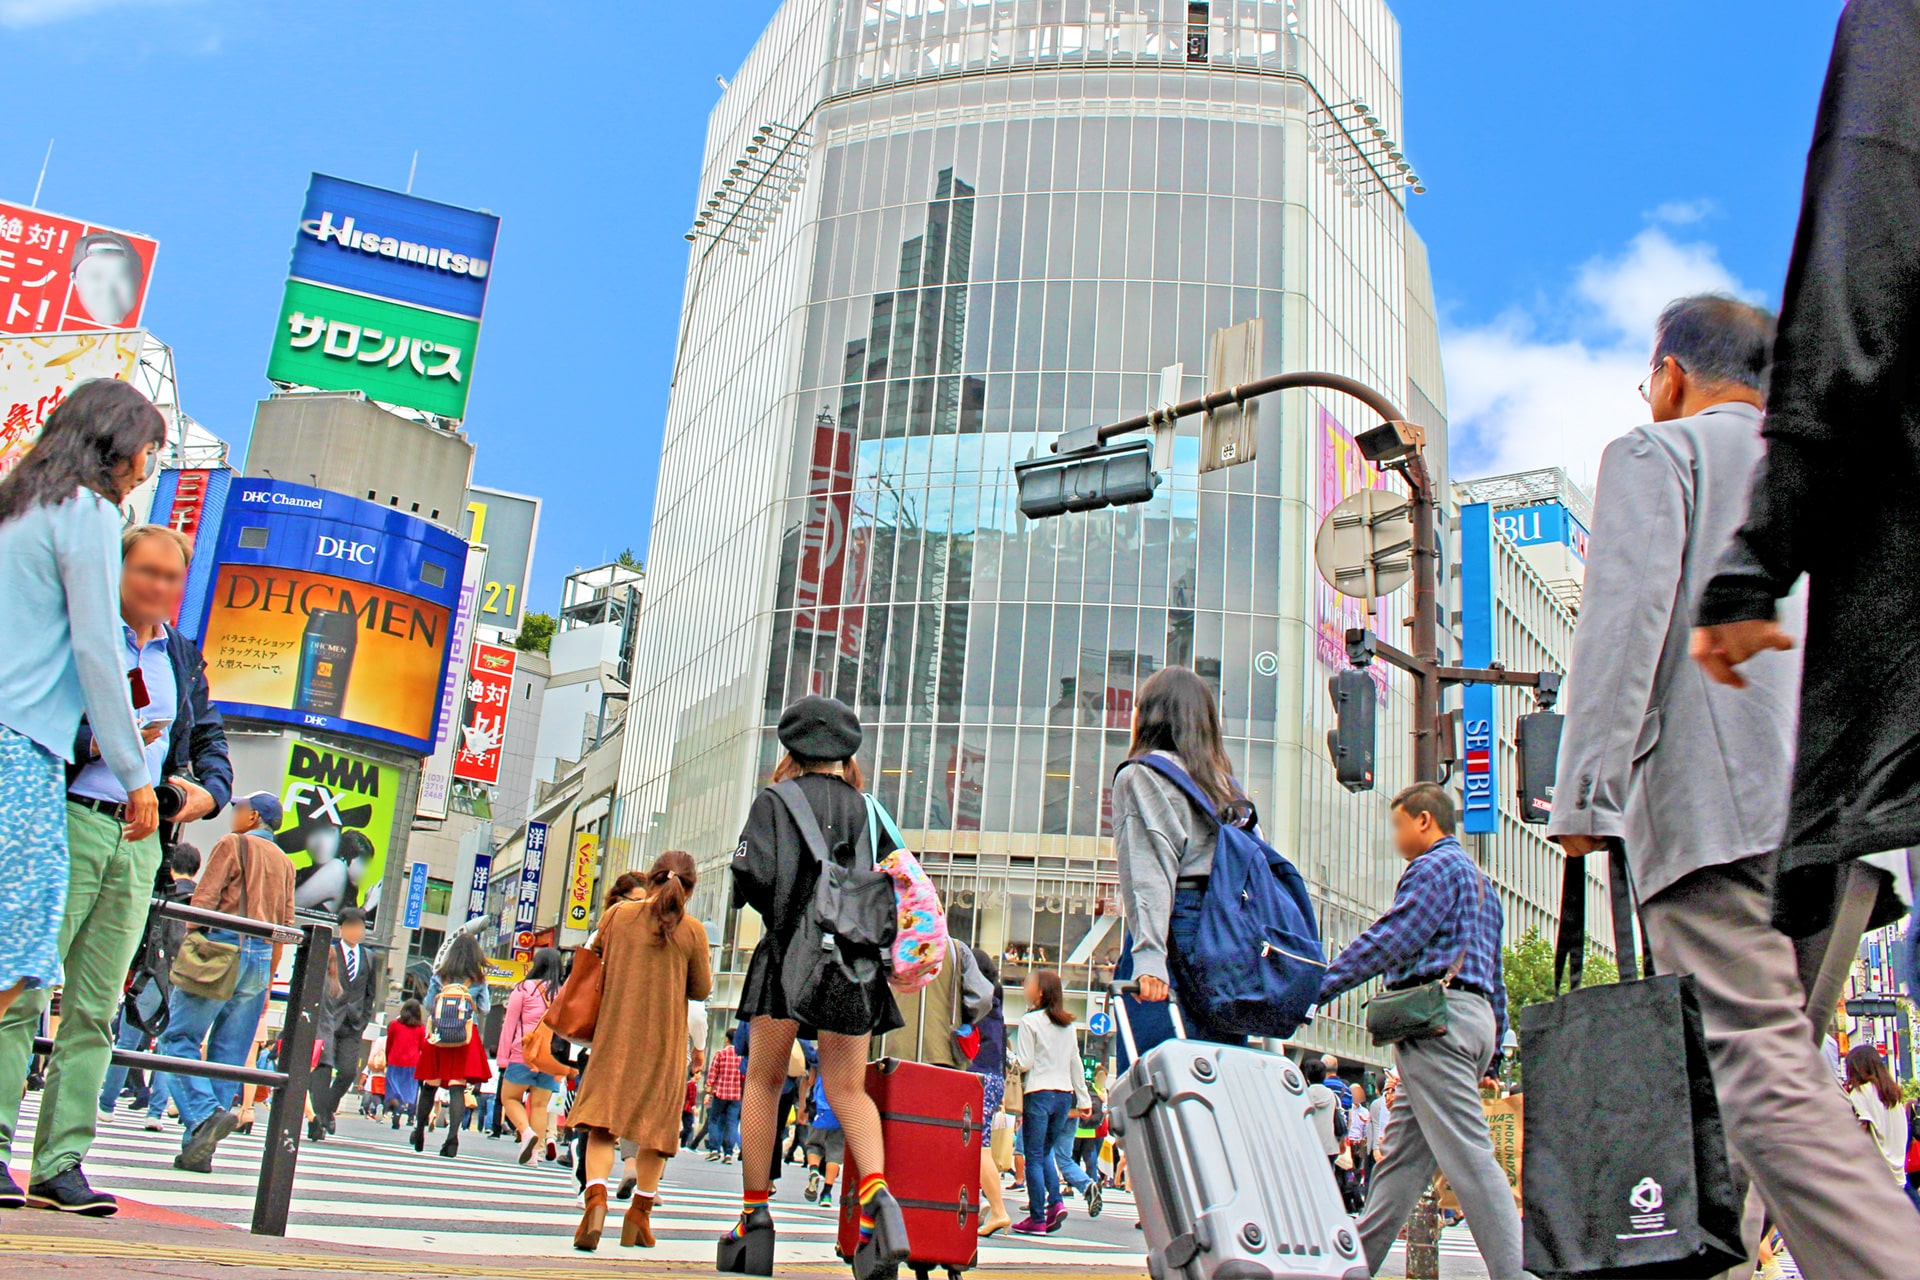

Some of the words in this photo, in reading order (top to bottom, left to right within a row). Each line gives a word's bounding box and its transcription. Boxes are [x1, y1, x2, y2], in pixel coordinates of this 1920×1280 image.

[0, 214, 69, 254] 絶対!
[301, 211, 489, 279] Hisamitsu
[288, 311, 462, 383] サロンパス
[242, 490, 271, 504] DHC
[272, 493, 323, 510] Channel
[1499, 511, 1543, 543] BU
[316, 535, 376, 565] DHC
[482, 581, 516, 616] 21
[219, 645, 279, 660] ドラッグストア
[467, 678, 508, 708] 絶対
[304, 714, 327, 727] DHC
[289, 743, 379, 799] DMM
[458, 746, 497, 769] だぞ!
[1466, 719, 1491, 814] SEIBU
[425, 781, 444, 792] 3719
[427, 773, 445, 784] (03)
[282, 781, 347, 826] FX
[423, 789, 443, 800] 2468
[517, 826, 545, 924] 洋服の青山
[571, 906, 586, 919] 4F
